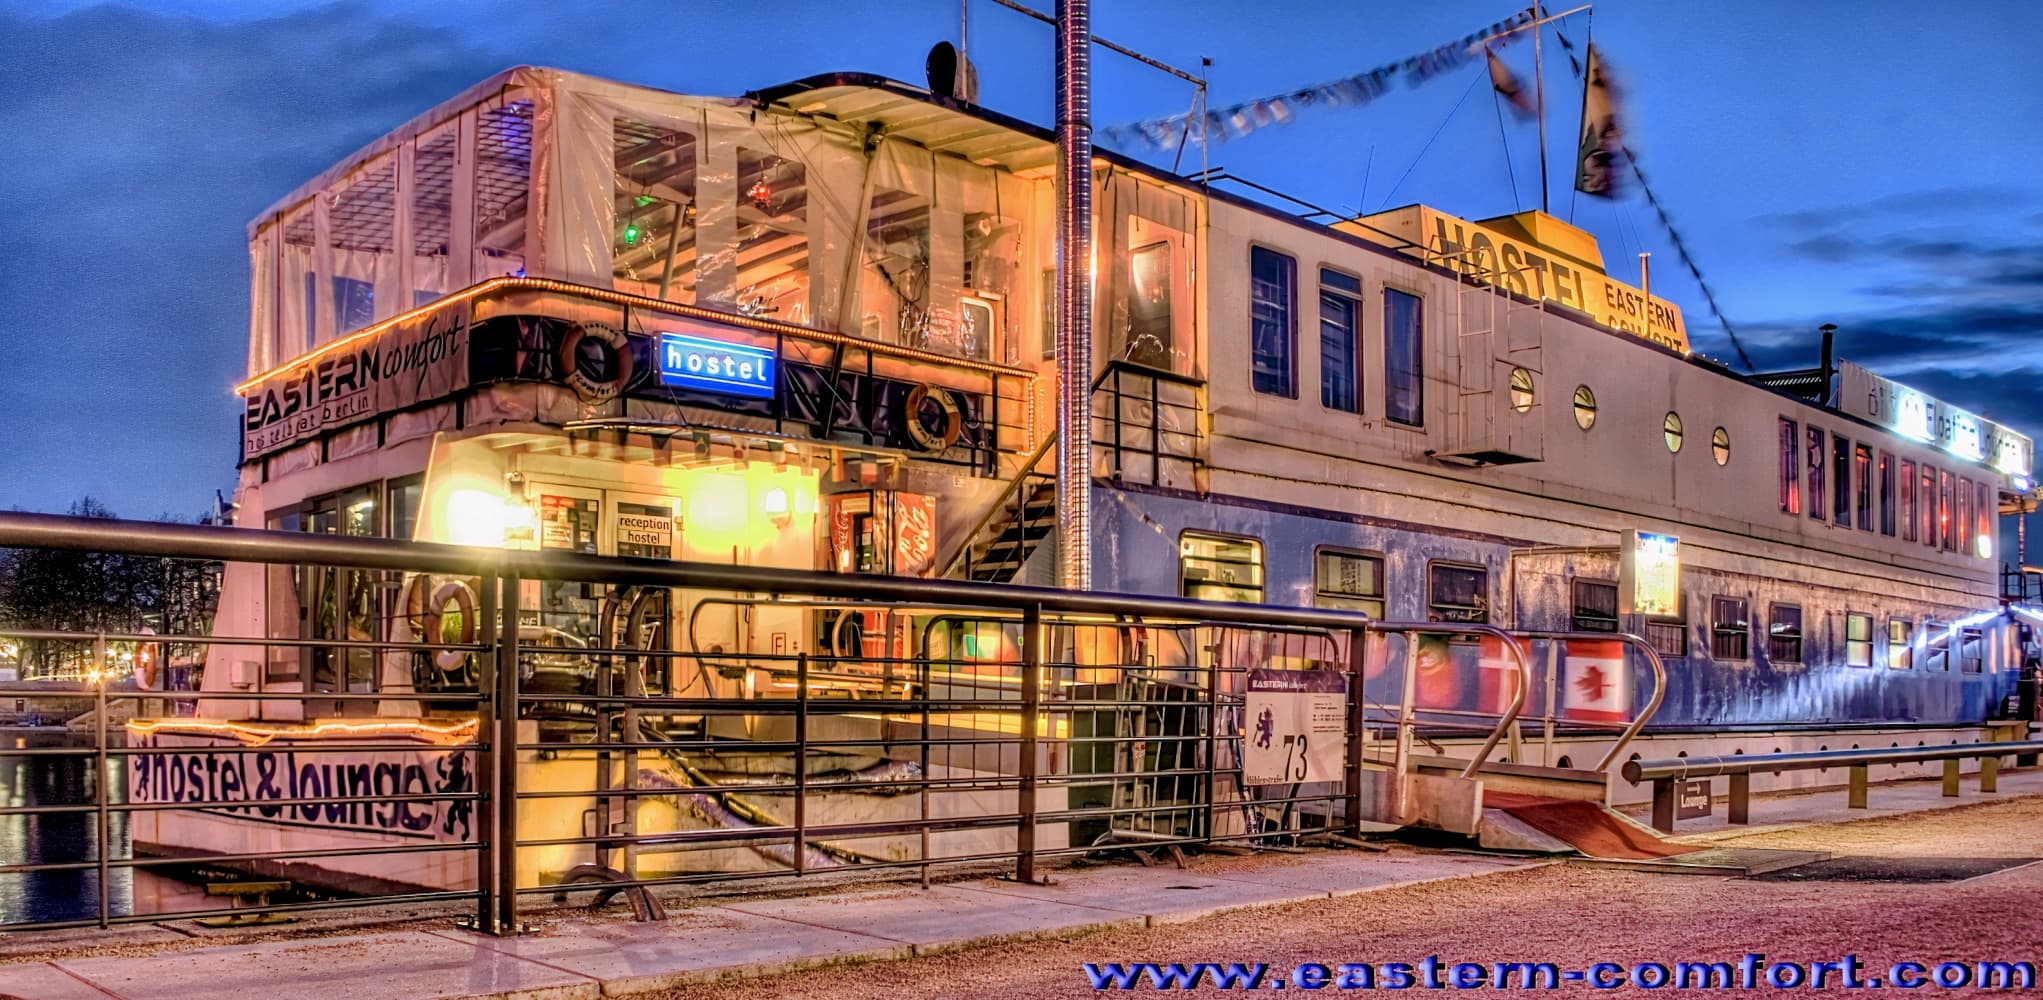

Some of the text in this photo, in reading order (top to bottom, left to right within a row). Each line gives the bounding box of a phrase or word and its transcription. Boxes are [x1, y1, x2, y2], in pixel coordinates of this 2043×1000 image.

[1436, 217, 1586, 312] HOSTEL
[1605, 283, 1677, 333] EASTERN
[247, 315, 464, 431] EASTERN comfort
[667, 344, 767, 382] hostel
[323, 395, 369, 420] berlin
[619, 516, 670, 531] reception
[627, 530, 661, 545] hostel
[1252, 679, 1289, 689] EASTERN
[1283, 734, 1308, 782] 73
[151, 736, 434, 832] hostel & lounge
[1680, 793, 1708, 810] Lounge
